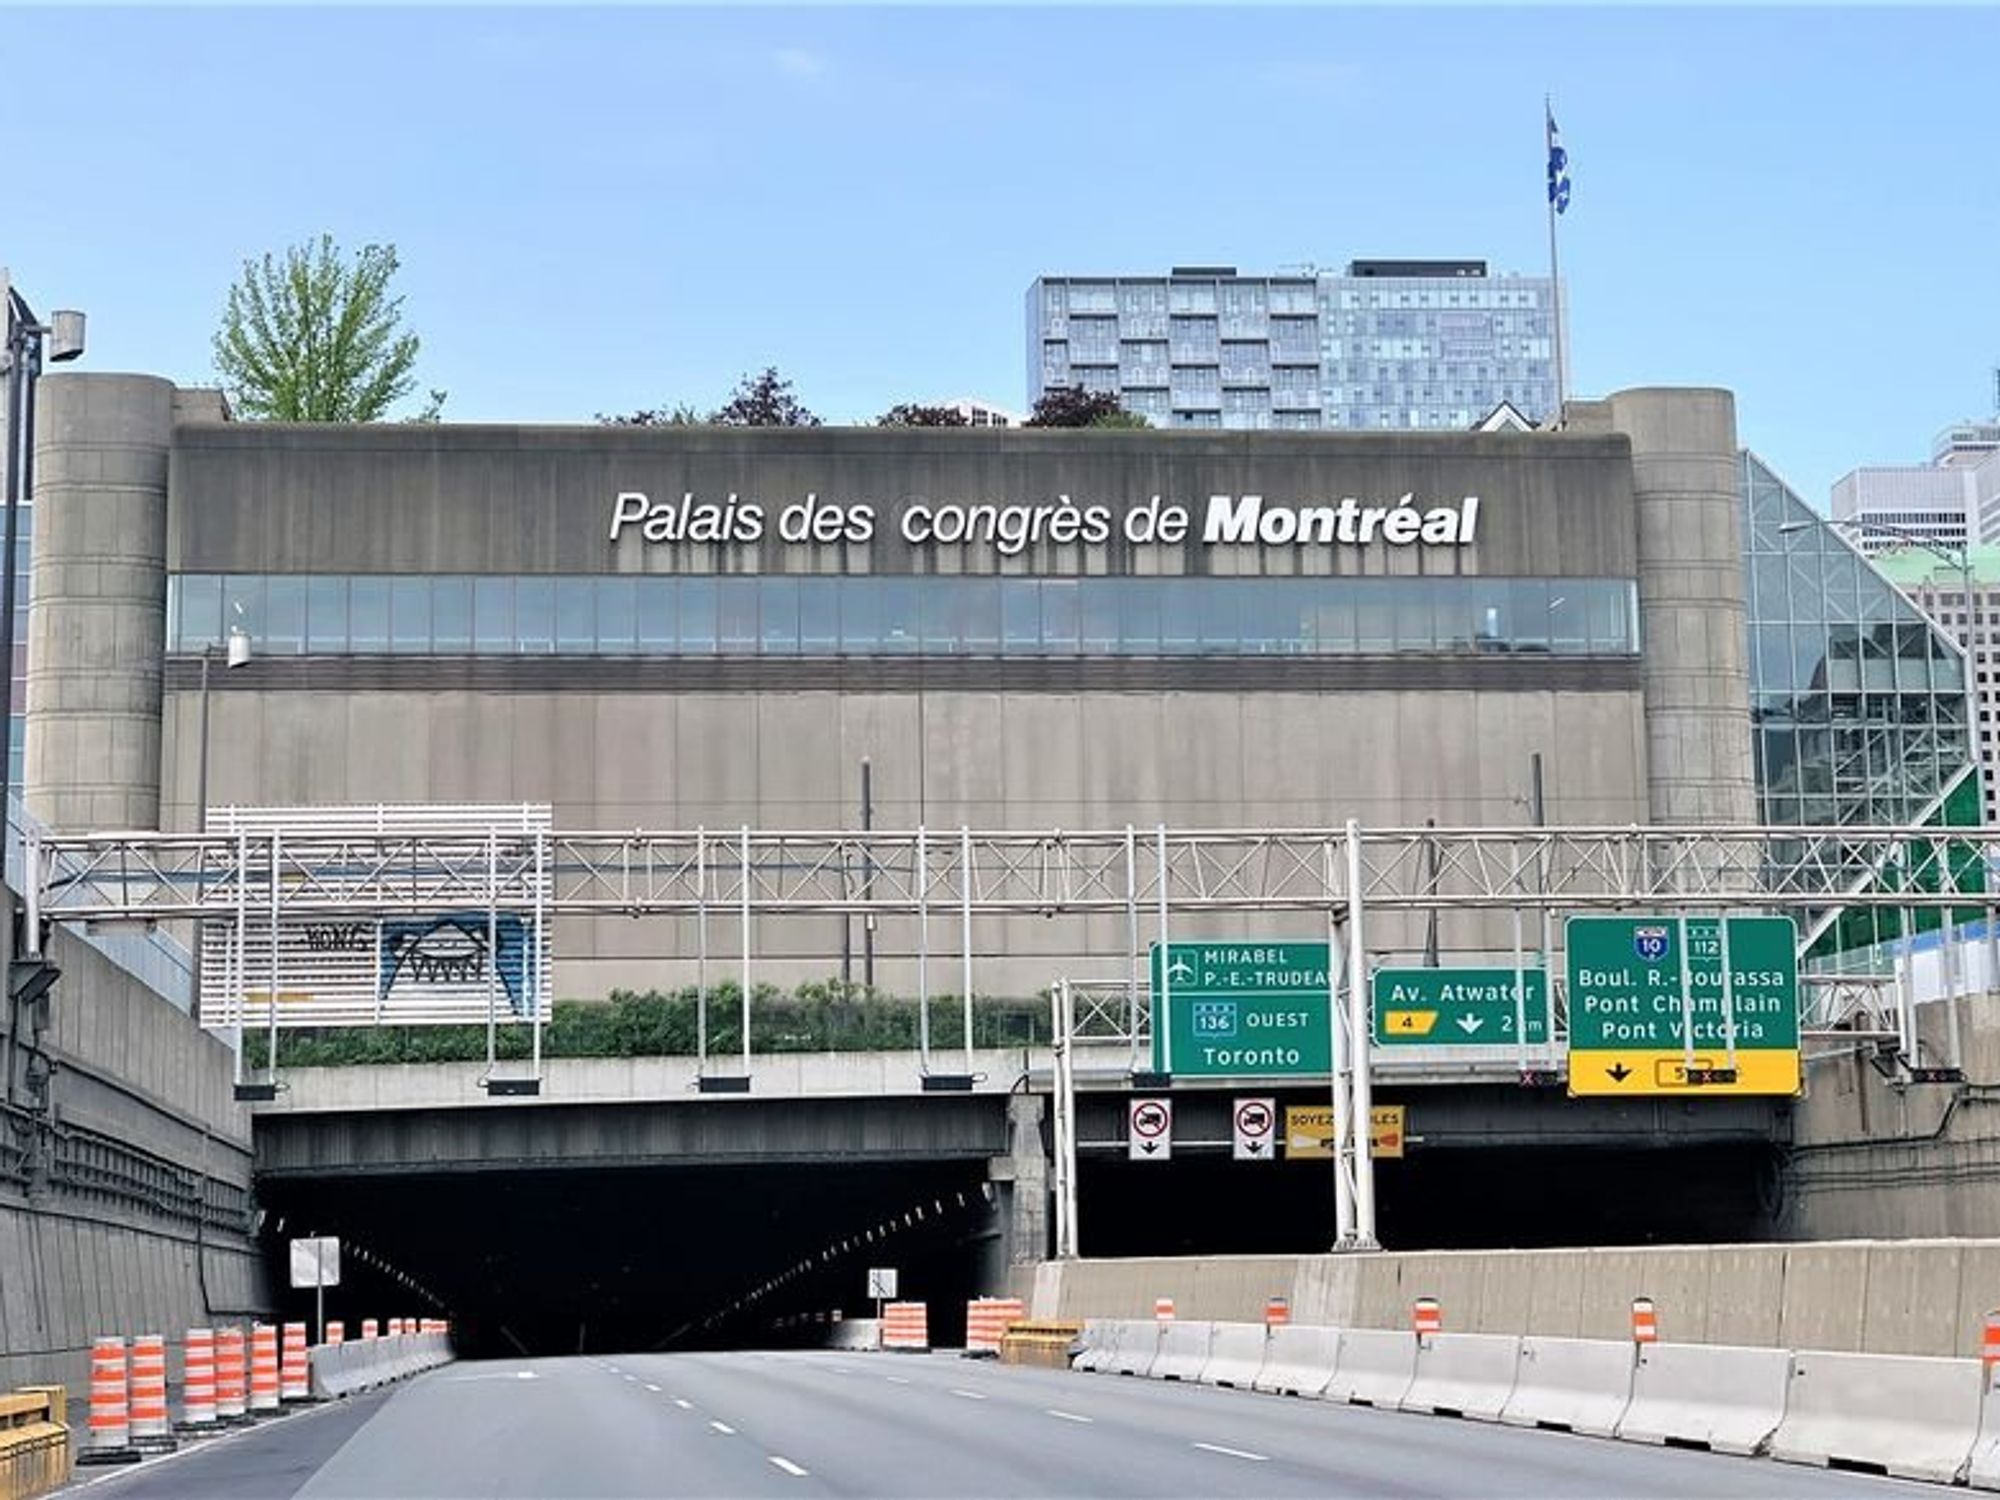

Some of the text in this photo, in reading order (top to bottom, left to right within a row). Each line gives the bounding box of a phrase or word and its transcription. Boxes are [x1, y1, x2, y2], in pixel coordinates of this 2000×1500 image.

[609, 492, 1478, 553] Palais des congrès de Montréal
[1642, 938, 1662, 953] 10
[1694, 940, 1720, 955] 112
[1203, 949, 1289, 965] MIRABEL
[1578, 969, 1637, 987] Boul.
[1390, 983, 1428, 1001] Av.
[1584, 995, 1640, 1014] Pont
[1199, 1012, 1310, 1030] 136 OUEST
[1402, 1016, 1413, 1028] 4
[1500, 1014, 1513, 1033] 2
[1601, 1020, 1765, 1040] Pont Vctoria
[1202, 1047, 1300, 1066] Toronto
